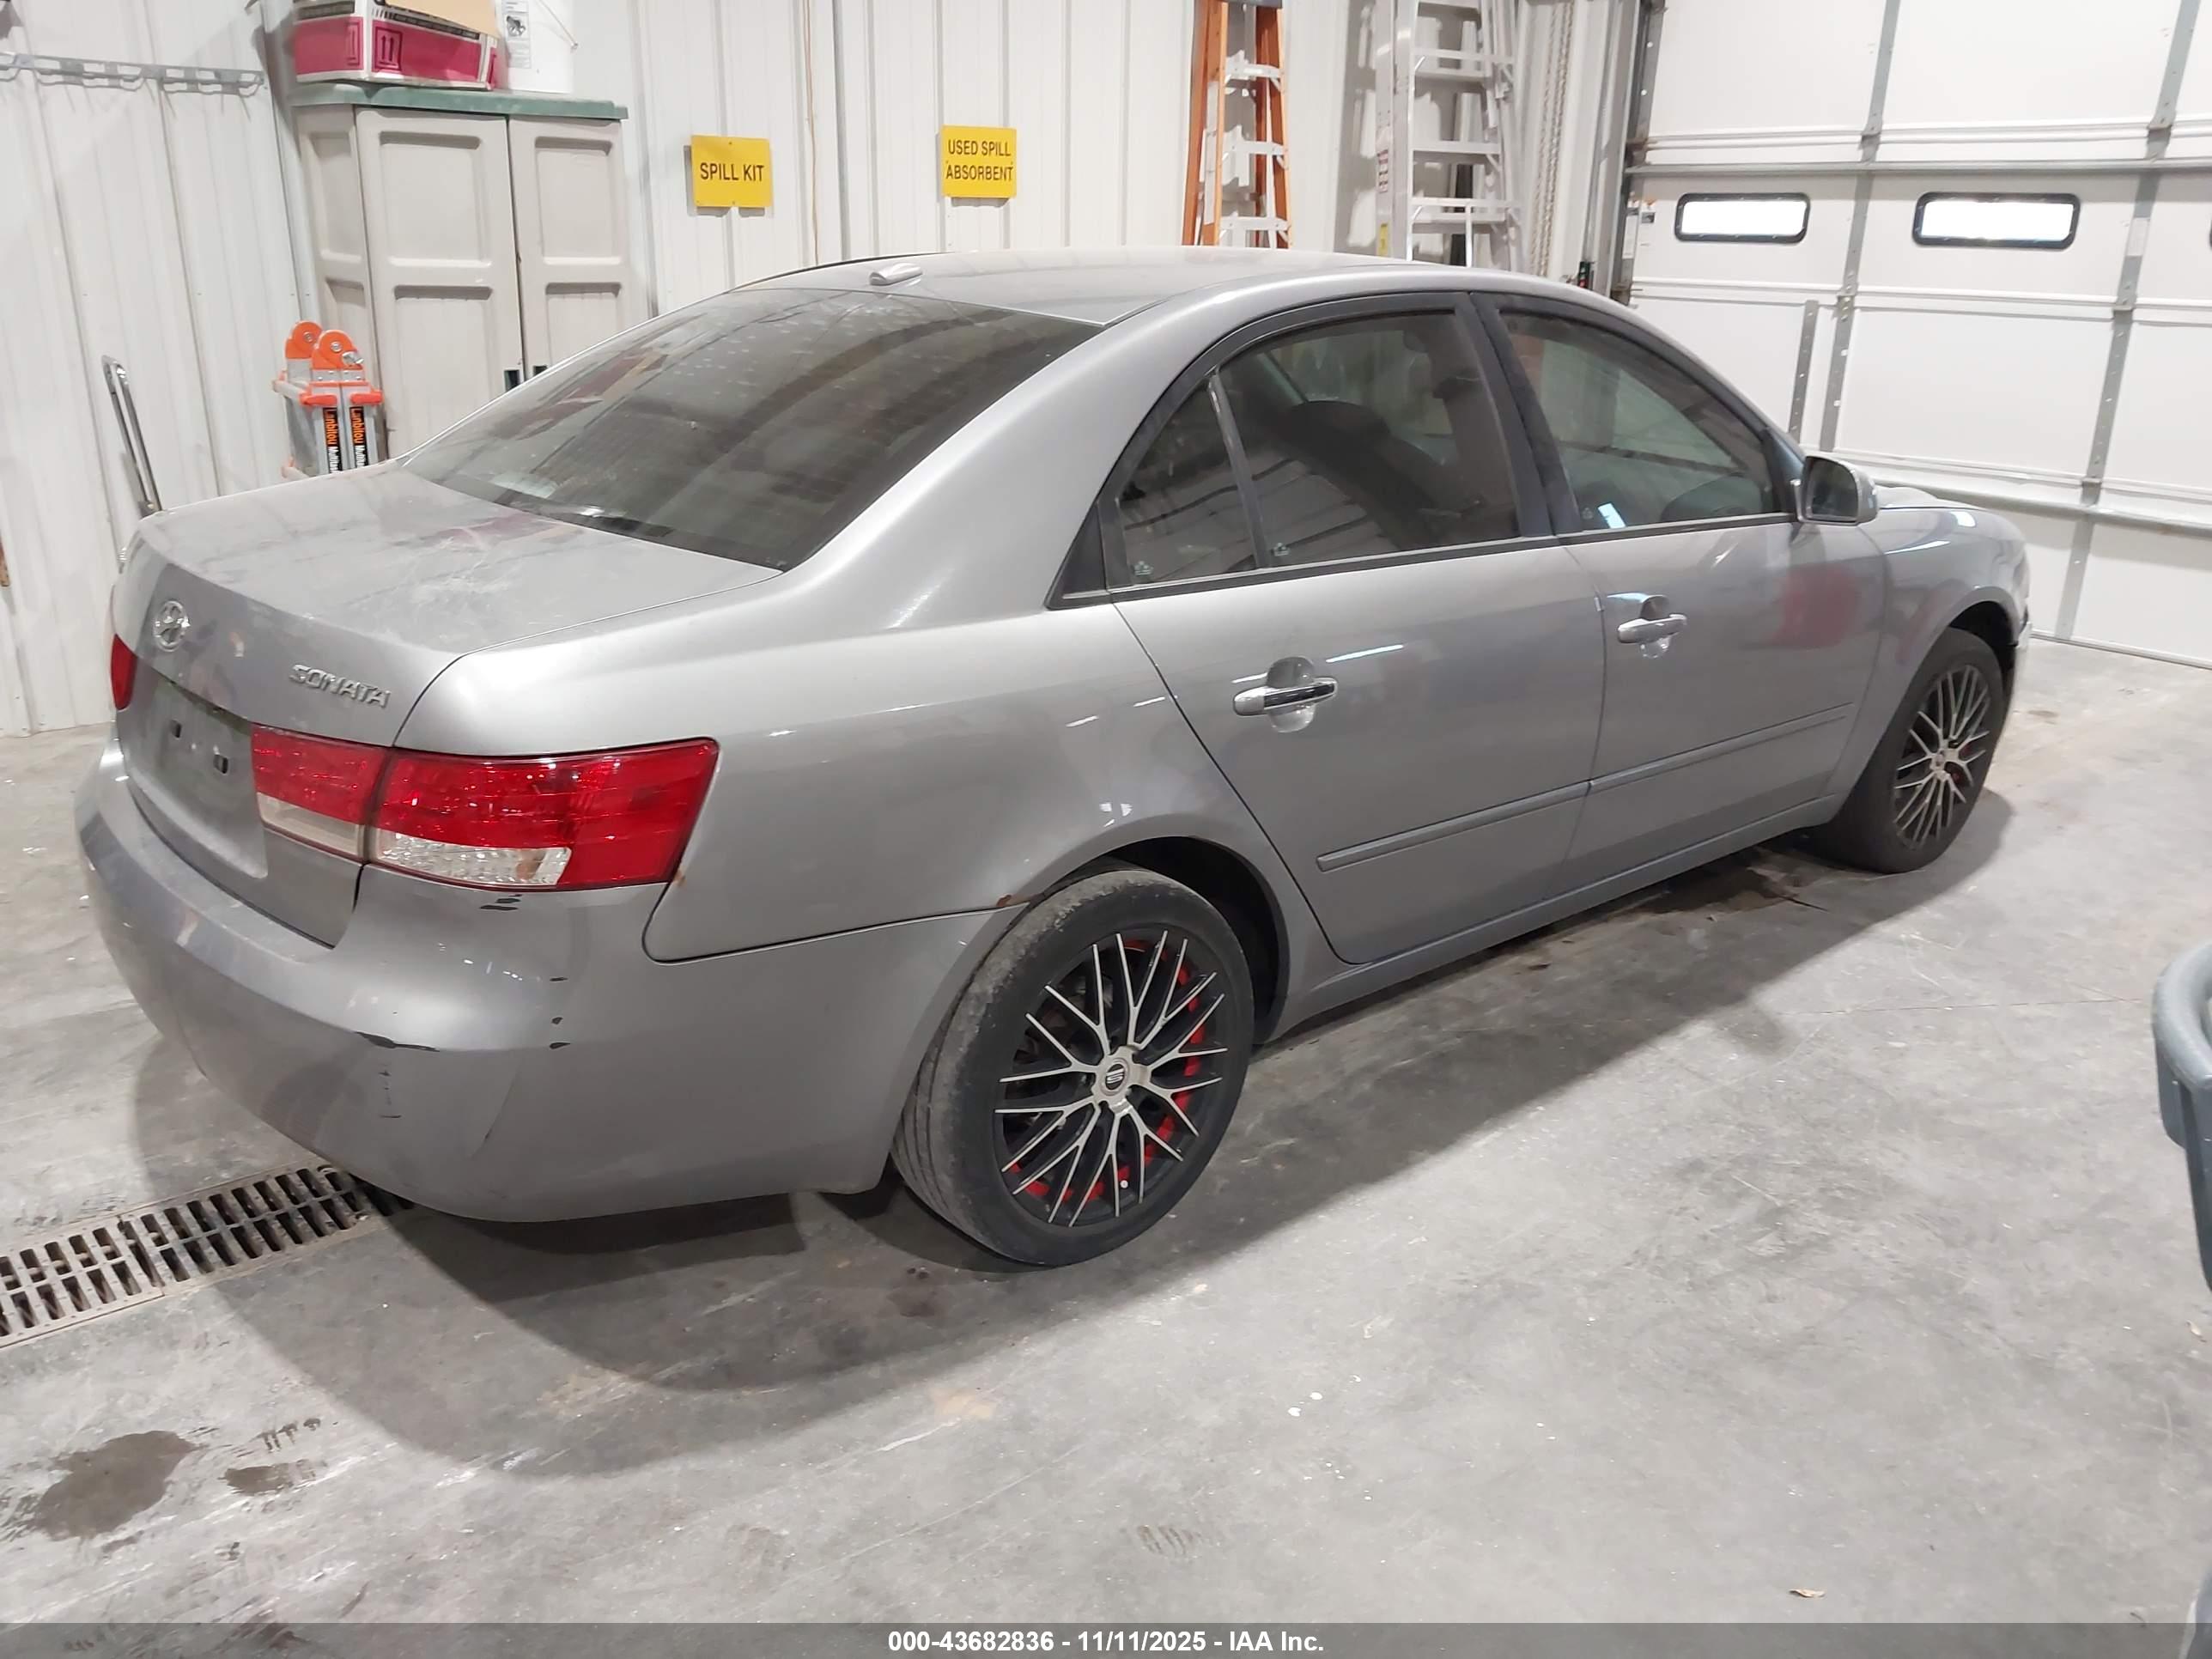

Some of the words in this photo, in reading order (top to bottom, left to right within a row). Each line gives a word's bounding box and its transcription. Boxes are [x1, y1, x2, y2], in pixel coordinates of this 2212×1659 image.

[947, 139, 978, 155] USED
[981, 141, 1012, 156] SPILL
[700, 162, 739, 181] SPILL
[743, 164, 765, 181] KIT
[945, 164, 1013, 182] ABSORBENT
[289, 664, 392, 708] SONATA
